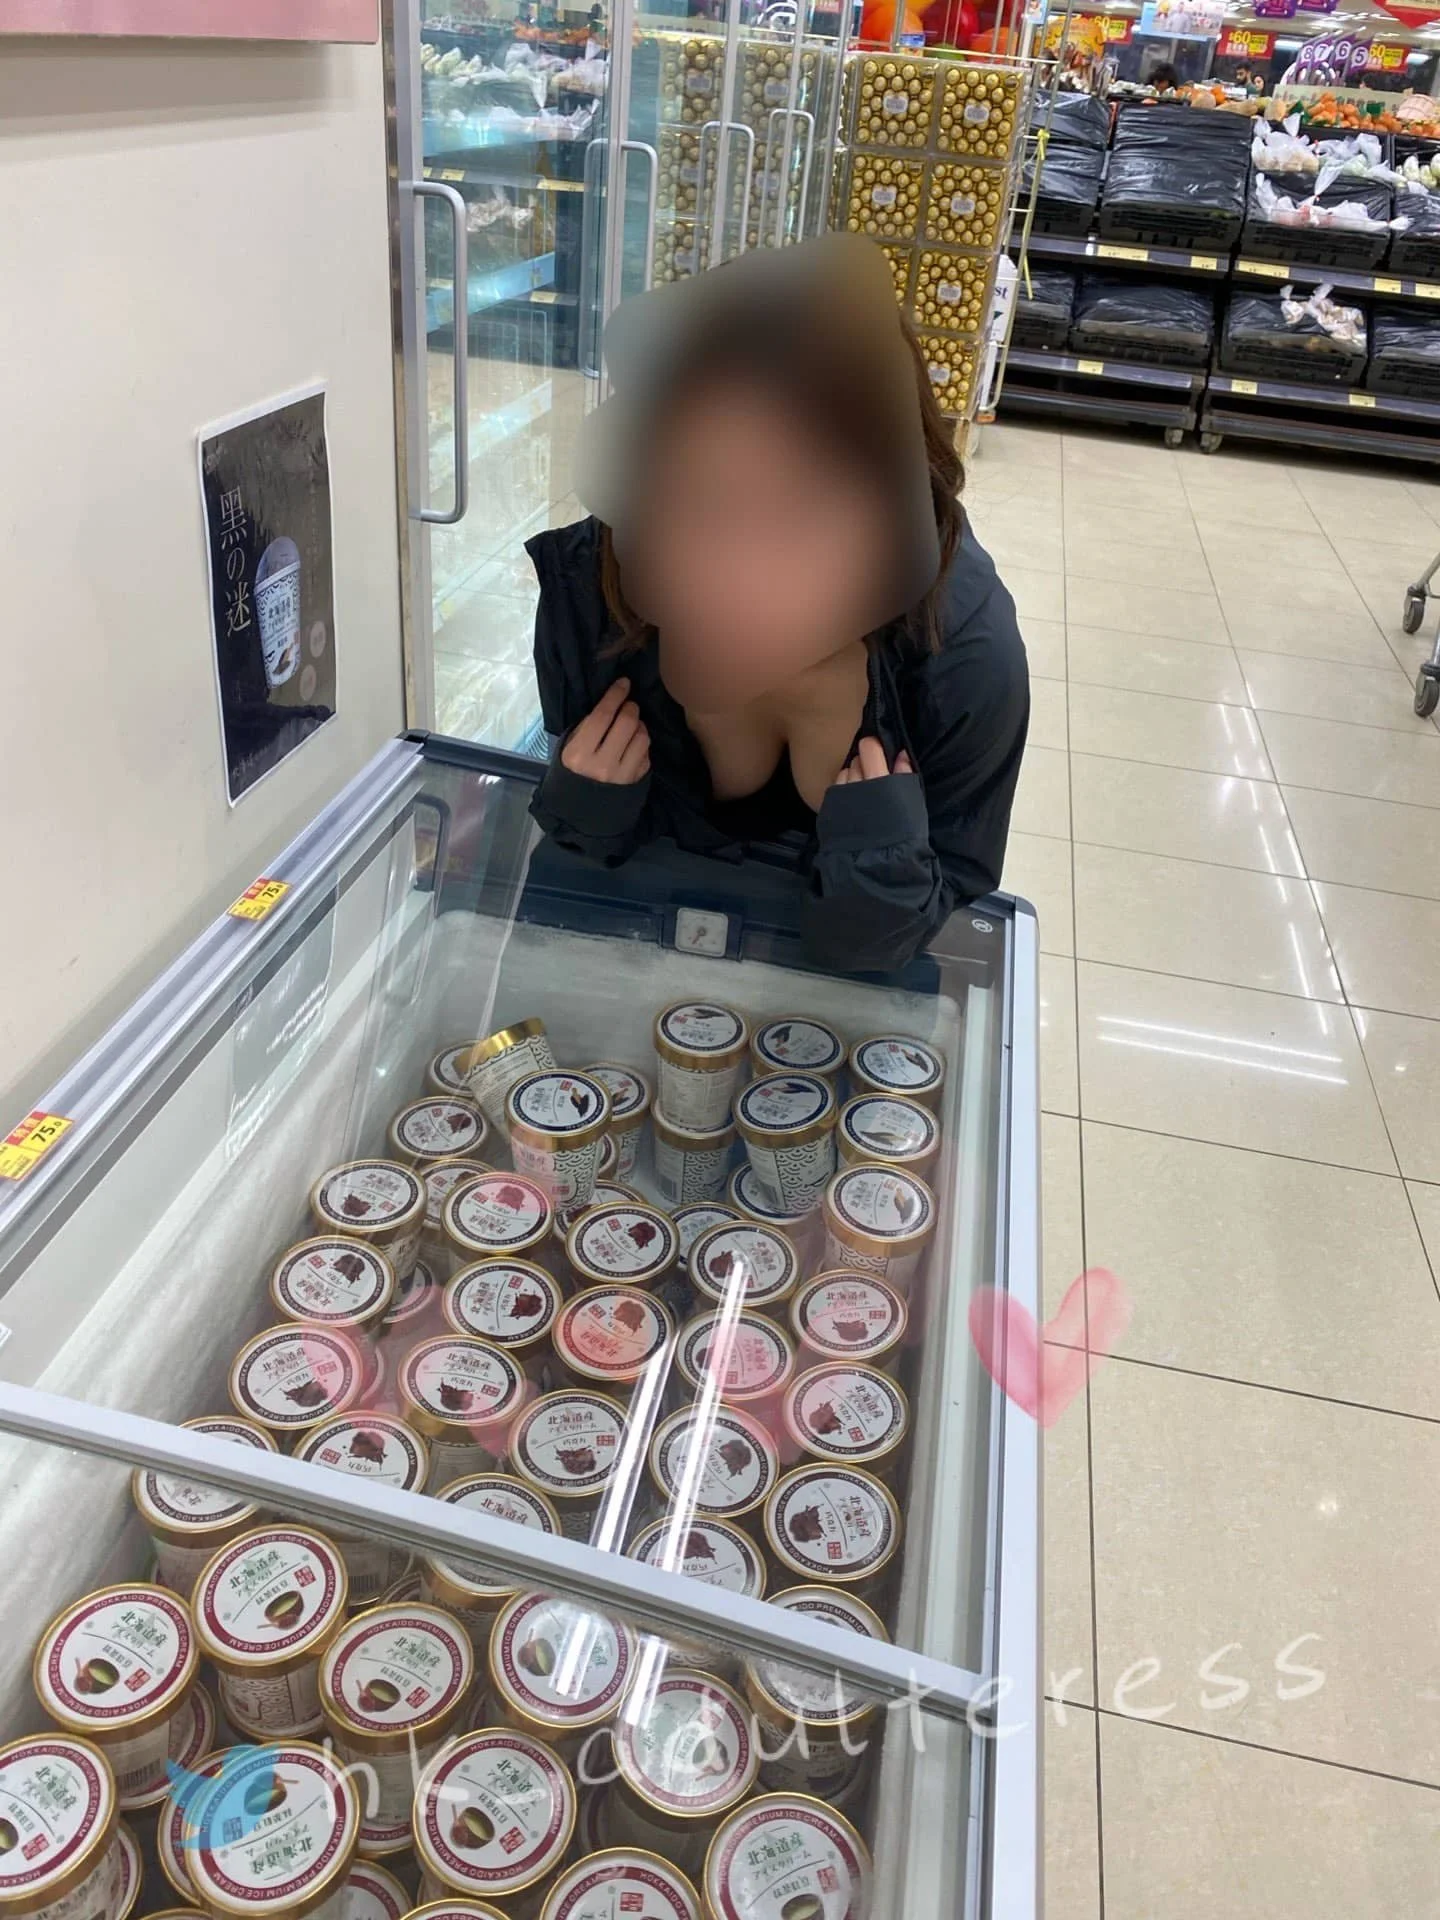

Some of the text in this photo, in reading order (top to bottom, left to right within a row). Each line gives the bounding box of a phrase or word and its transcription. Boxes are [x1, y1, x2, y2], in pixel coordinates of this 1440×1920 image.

[93, 1594, 144, 1612] HOKKAIDO
[143, 1595, 180, 1623] PREMIUM
[171, 1635, 186, 1668] CREAM
[227, 1635, 263, 1650] CREAM
[280, 1612, 322, 1645] PREMIUM
[365, 1620, 413, 1637] HOKKAIDO
[413, 1620, 451, 1644] PREMIUM
[10, 1746, 64, 1763] HOKKAIDO
[469, 1739, 520, 1754] HOKKAIDO
[802, 1813, 838, 1841] CREAM
[312, 1816, 344, 1869] HOKKAIDO
[432, 1835, 471, 1873] PREMIUM
[210, 1869, 246, 1895] CREAM
[264, 1865, 316, 1896] PREMIUM
[470, 1861, 524, 1877] HOKKAIDO
[638, 1870, 686, 1913] HOKKAIDO
